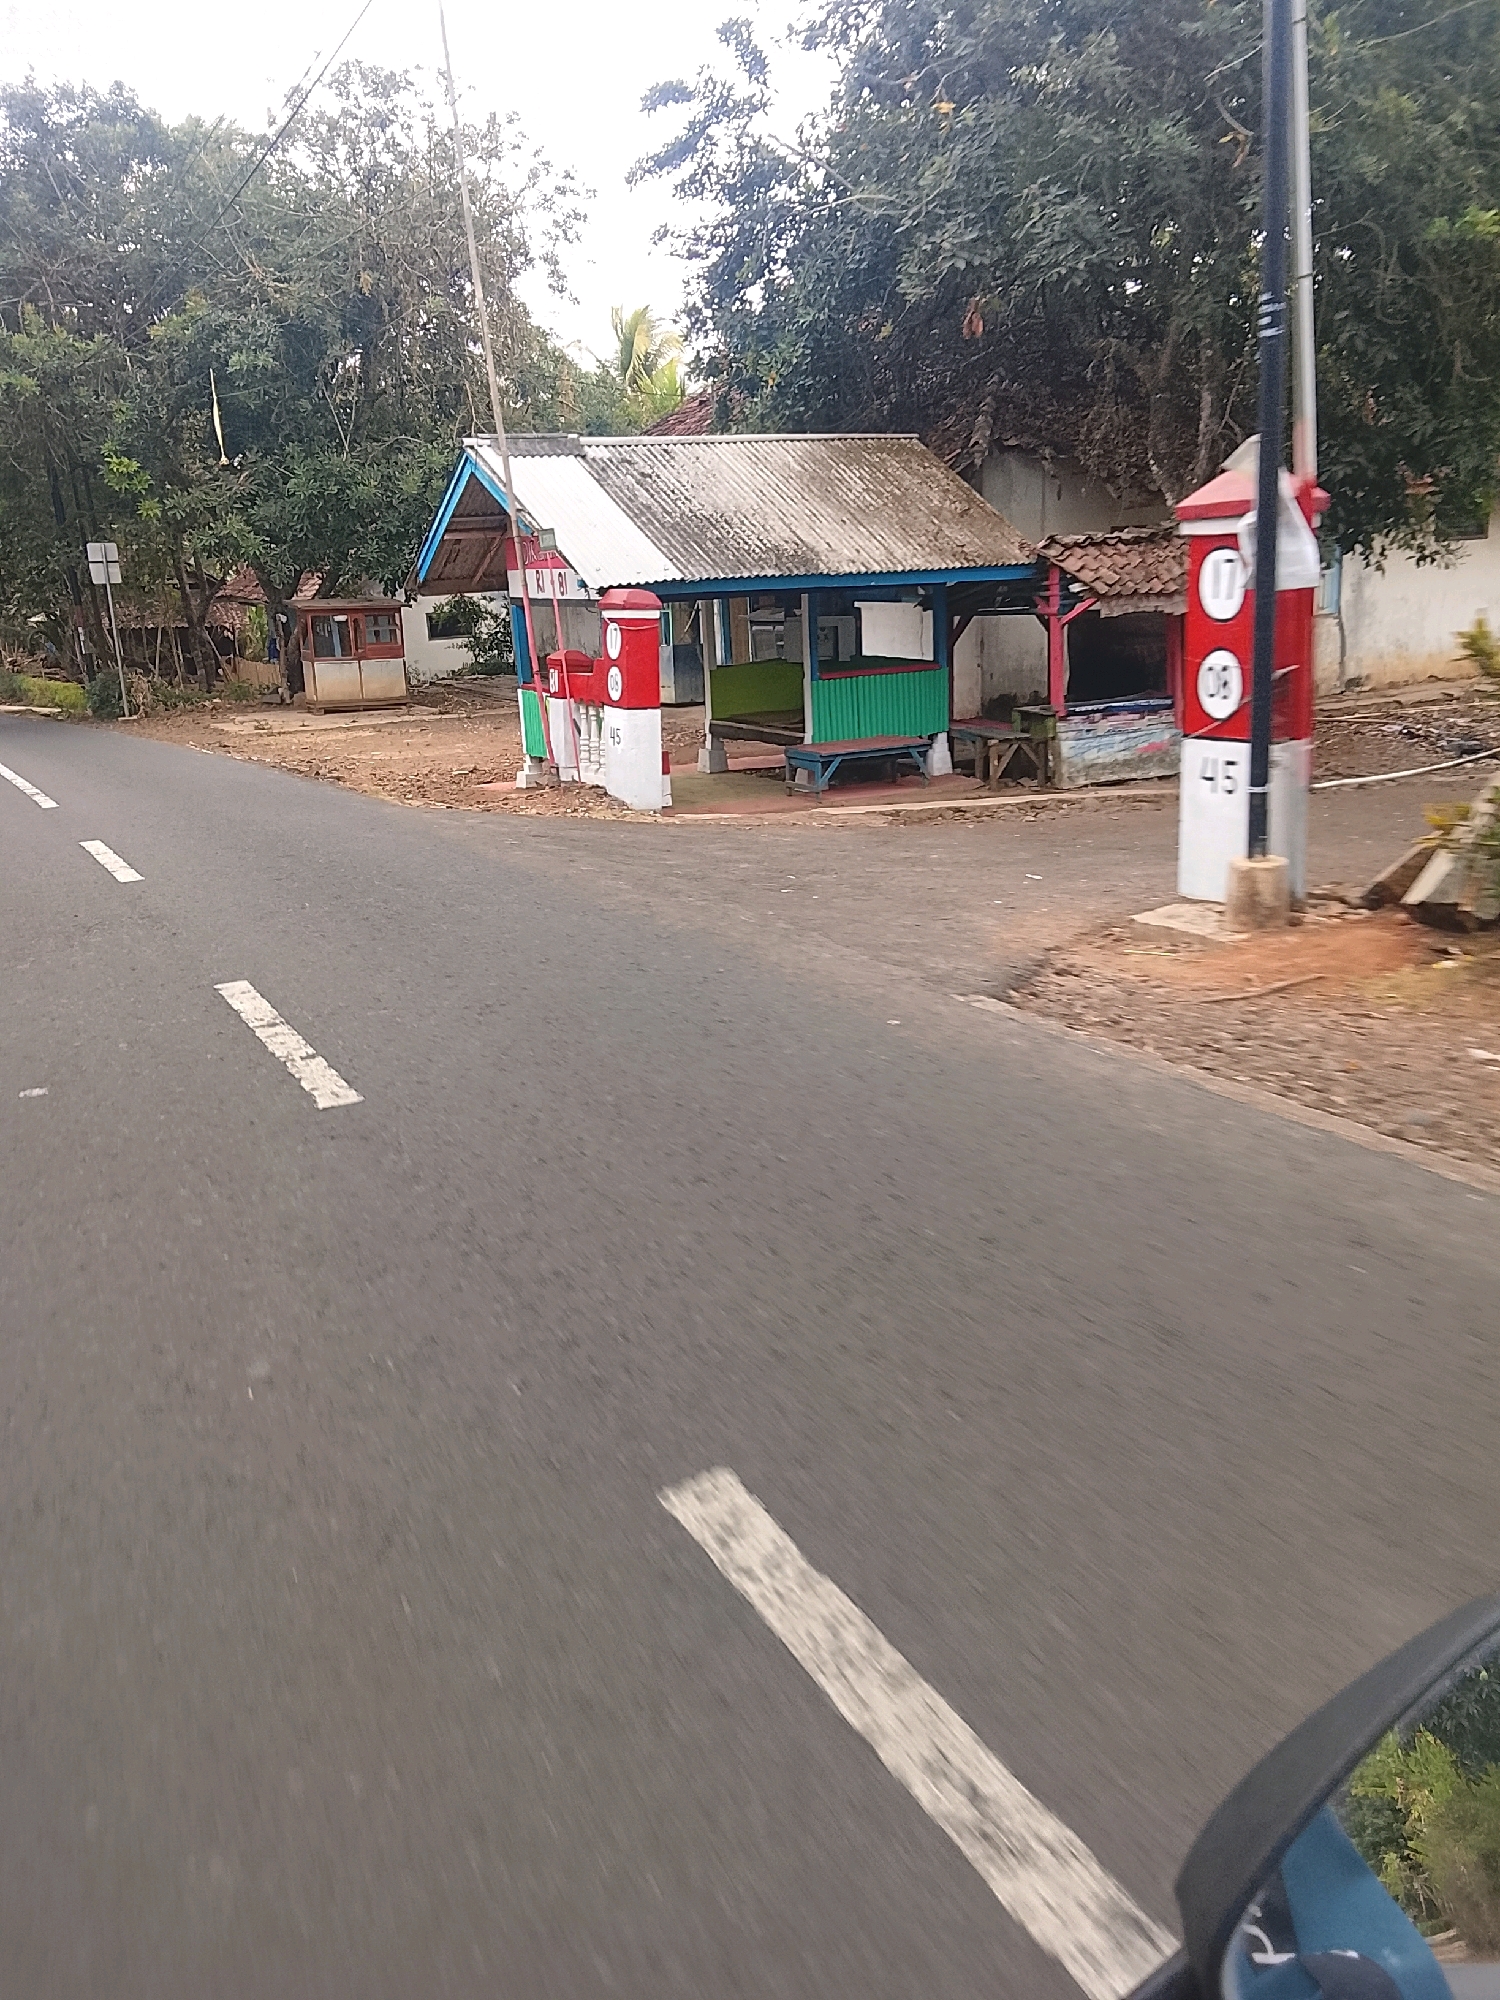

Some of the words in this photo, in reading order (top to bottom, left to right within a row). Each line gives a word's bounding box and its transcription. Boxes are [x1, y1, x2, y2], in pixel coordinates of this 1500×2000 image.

[1212, 557, 1239, 600] 17
[609, 626, 618, 650] 17
[609, 673, 619, 692] 08
[1202, 665, 1233, 700] 08
[609, 725, 621, 746] 45
[1200, 756, 1237, 794] 45
